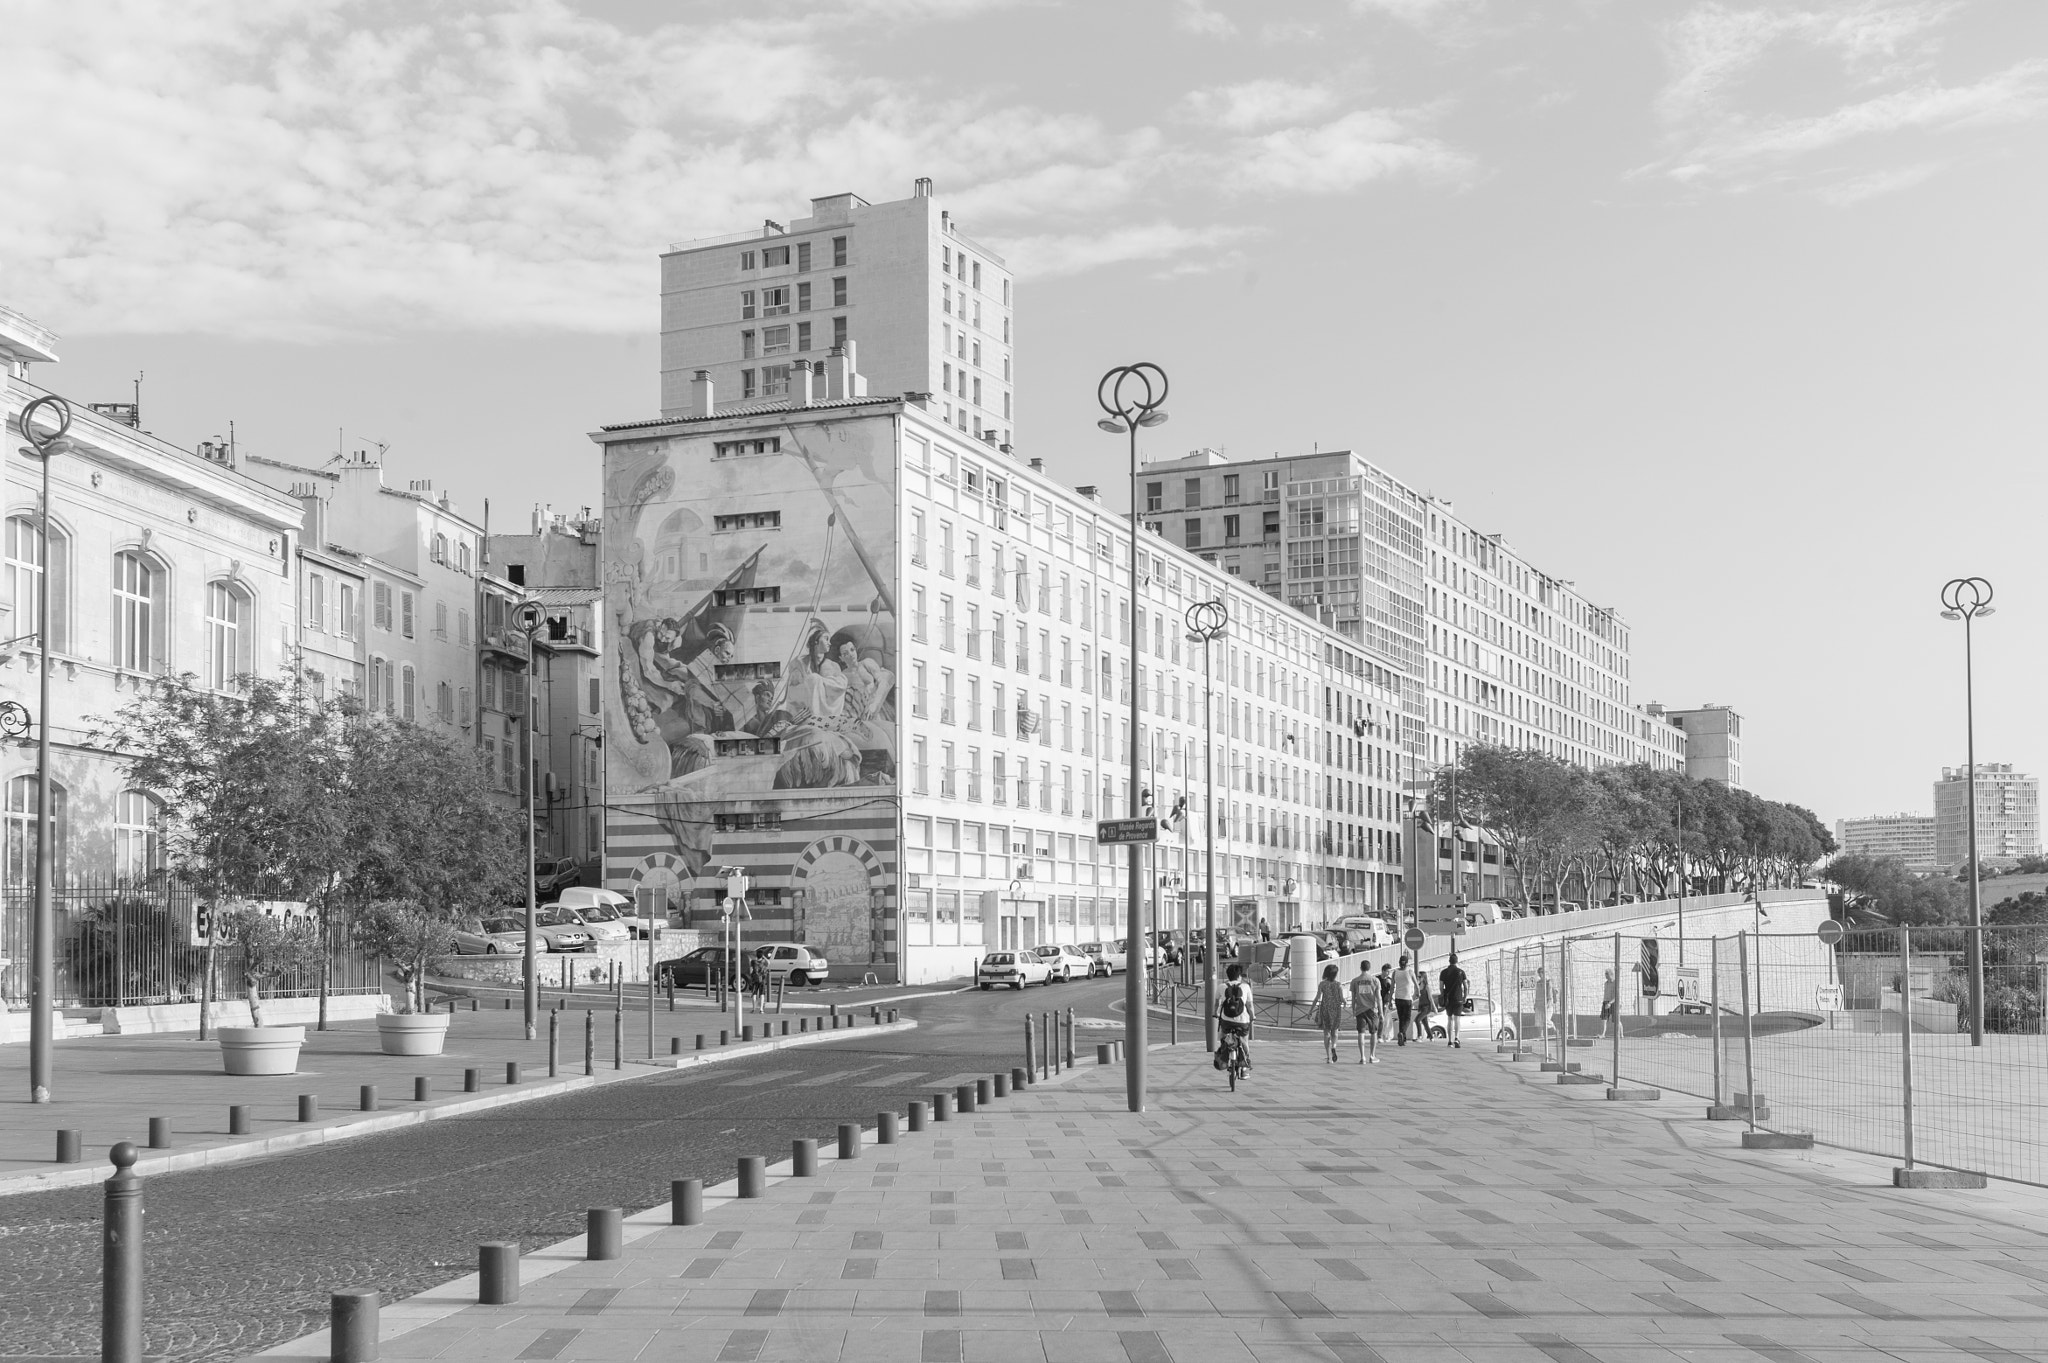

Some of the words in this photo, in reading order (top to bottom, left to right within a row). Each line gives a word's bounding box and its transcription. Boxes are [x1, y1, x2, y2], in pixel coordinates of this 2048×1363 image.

[1118, 822, 1135, 831] Musée
[1135, 821, 1155, 831] Regards
[1118, 832, 1125, 840] de
[1125, 831, 1148, 840] Provence
